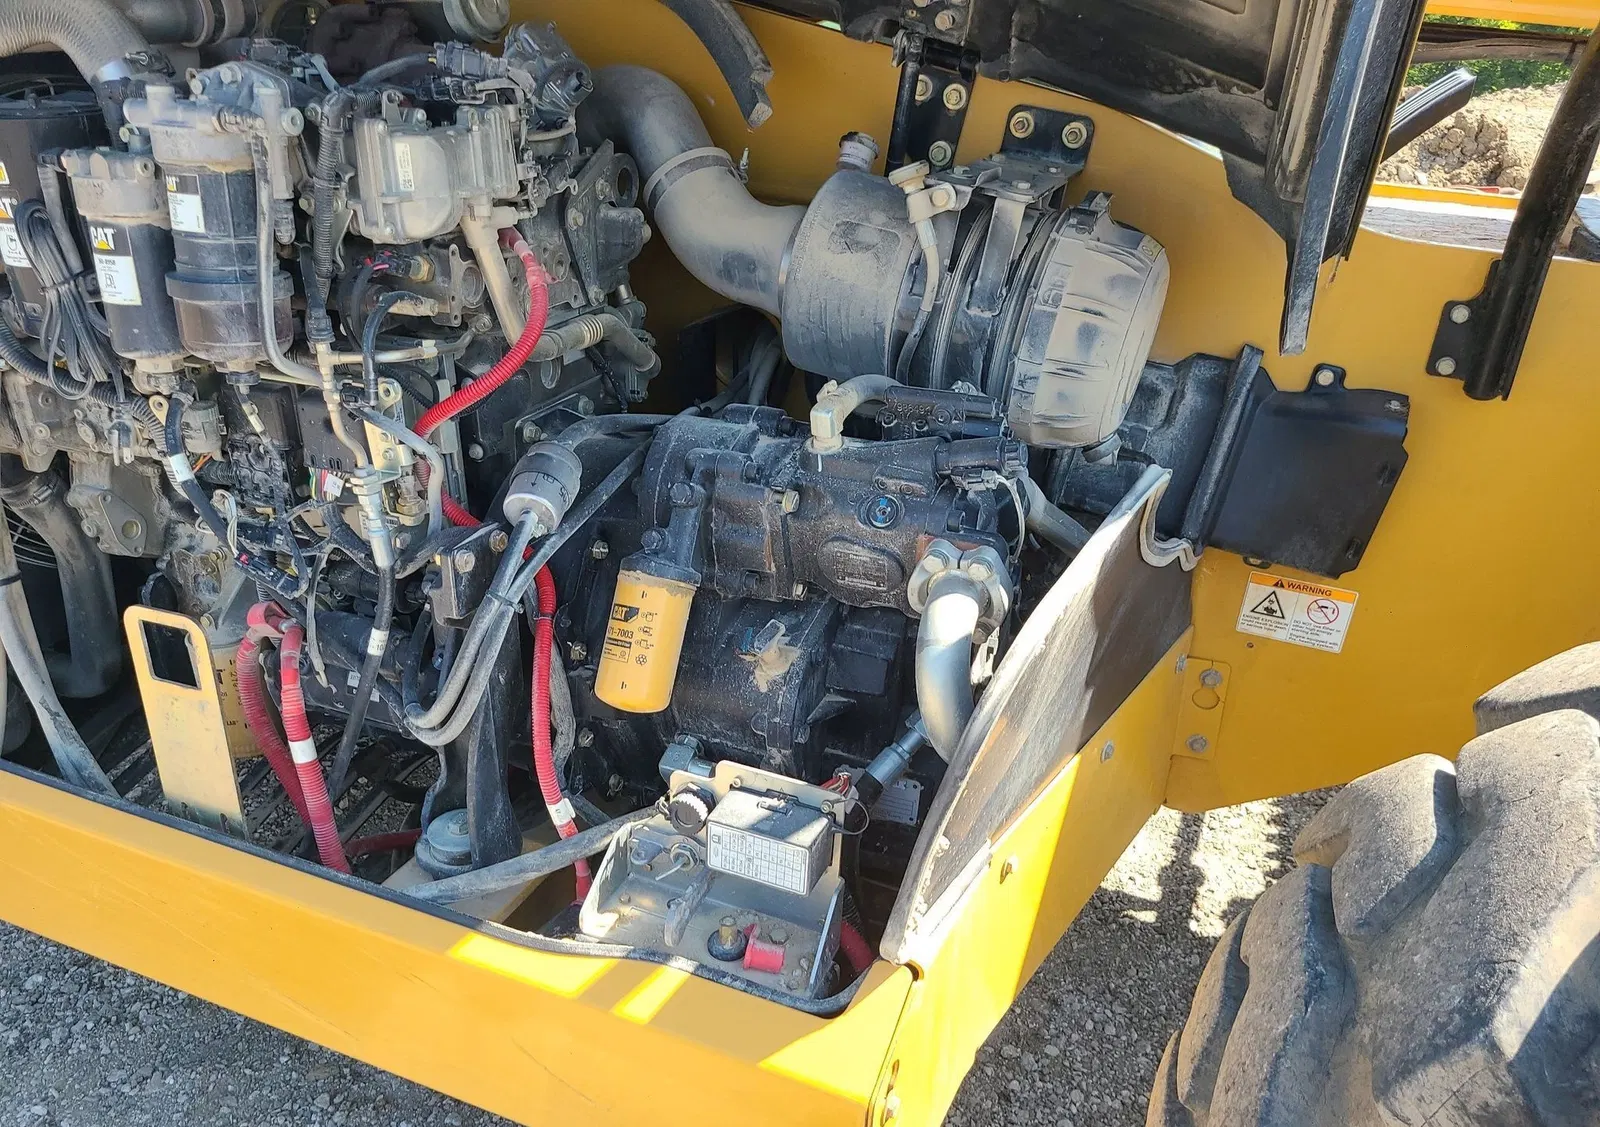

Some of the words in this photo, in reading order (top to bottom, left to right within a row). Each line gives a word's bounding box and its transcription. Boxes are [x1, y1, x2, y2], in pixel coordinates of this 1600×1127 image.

[90, 226, 115, 250] CAT
[1286, 582, 1332, 596] WARNING
[1260, 617, 1288, 626] EXPLOSION
